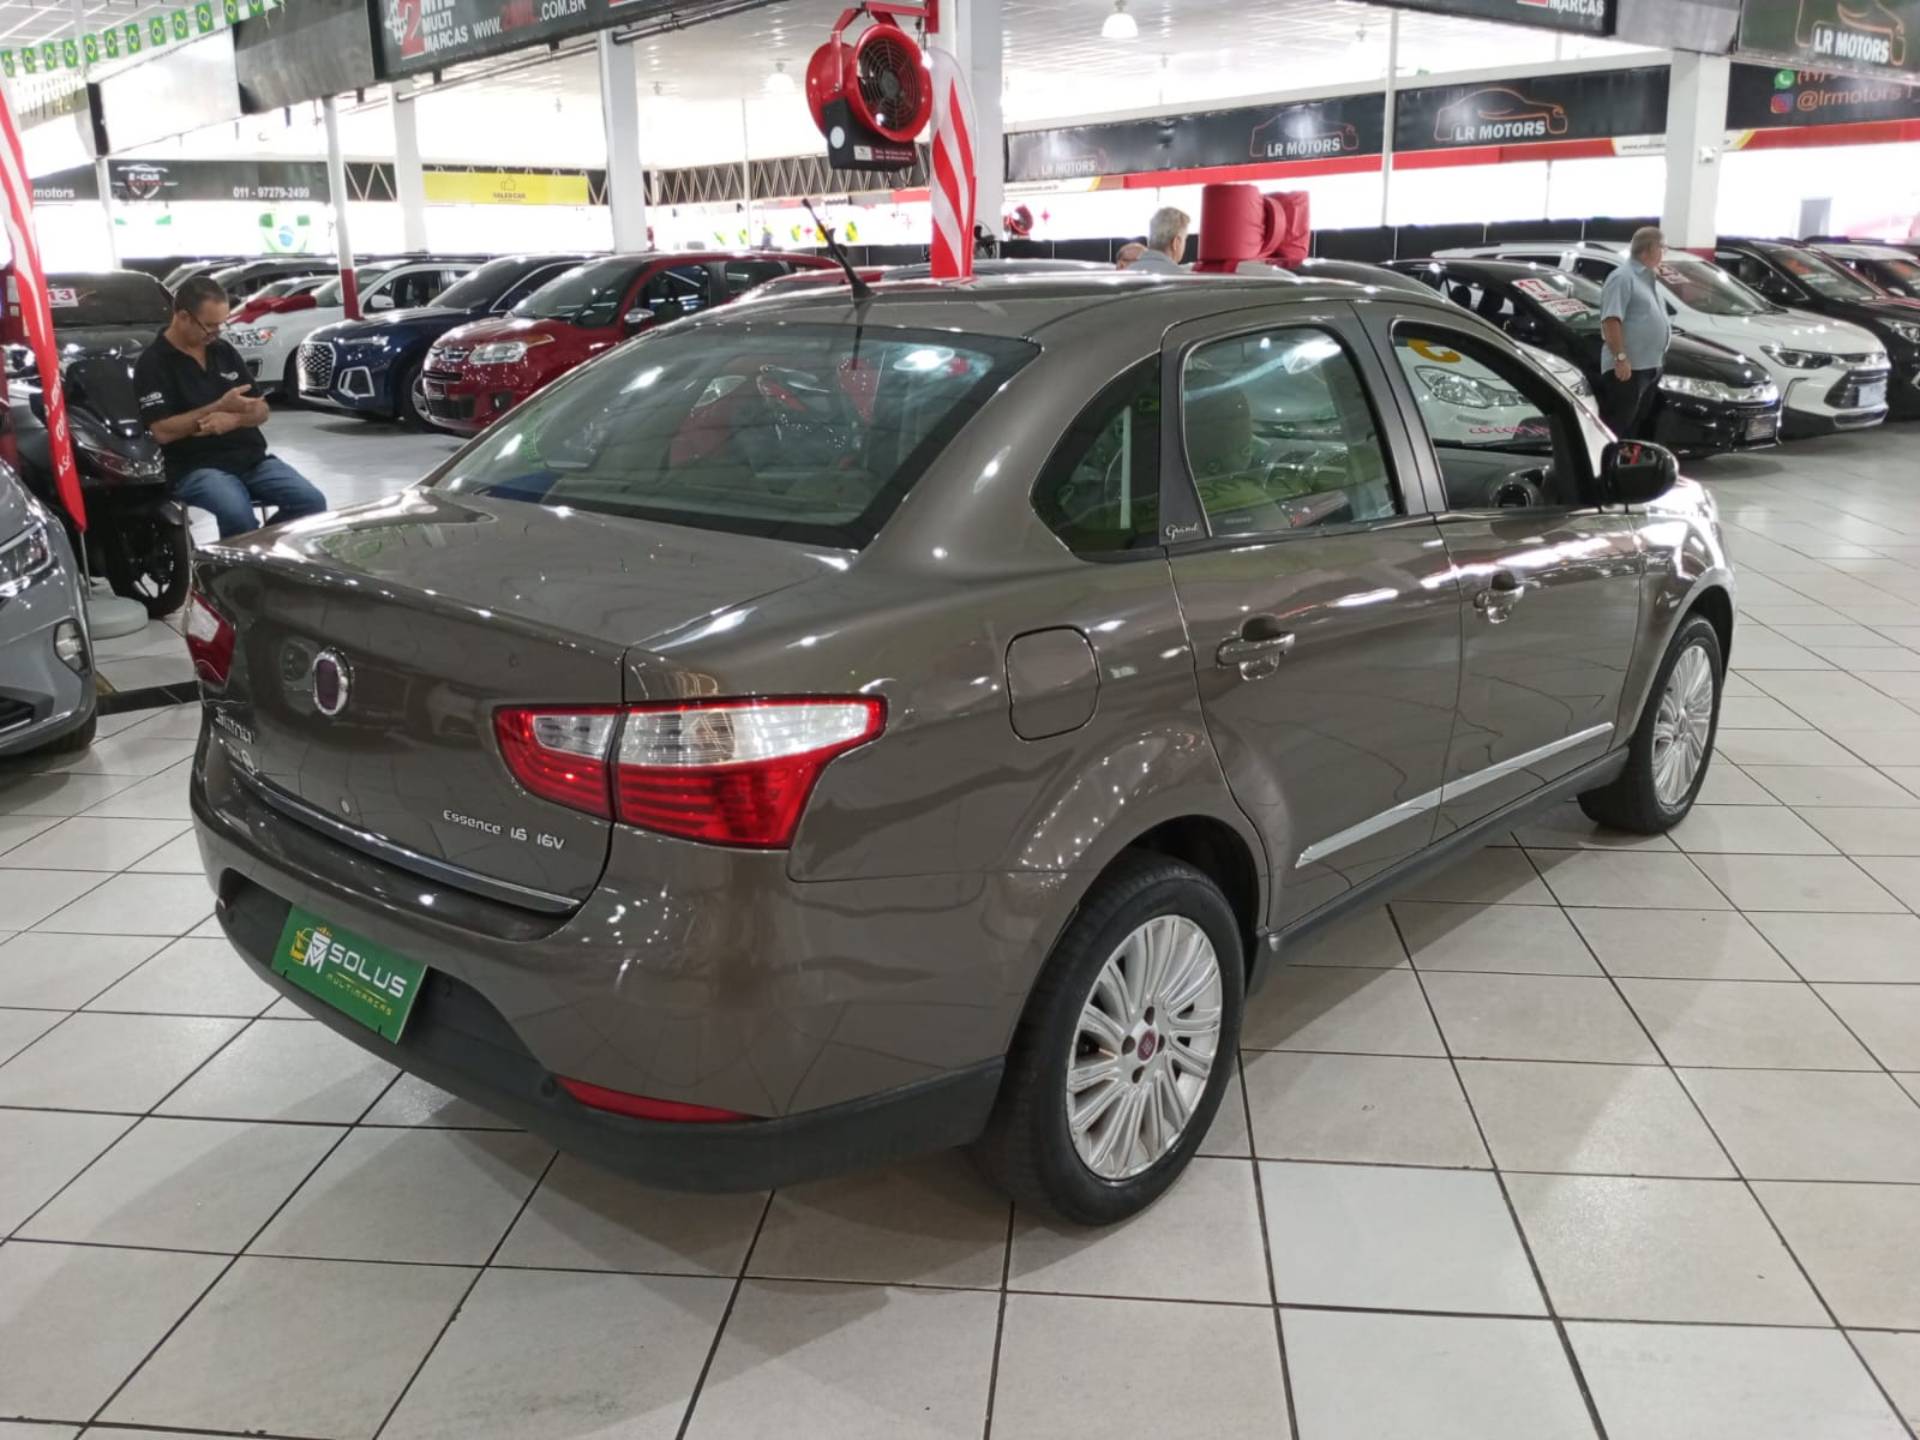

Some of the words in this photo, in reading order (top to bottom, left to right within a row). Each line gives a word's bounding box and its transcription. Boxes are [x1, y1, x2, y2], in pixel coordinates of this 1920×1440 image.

[422, 9, 452, 34] MULTI
[424, 25, 469, 55] MARCAS
[1814, 27, 1834, 55] LR
[1835, 31, 1890, 64] MOTORS
[1455, 126, 1476, 142] LR
[1479, 120, 1546, 140] MOTORS
[1267, 143, 1284, 158] LR
[1286, 137, 1341, 156] MOTORS
[33, 188, 75, 199] motors
[1165, 522, 1198, 540] Grand
[442, 809, 502, 836] Essence
[536, 833, 565, 850] 16V
[328, 942, 408, 999] SOLUS
